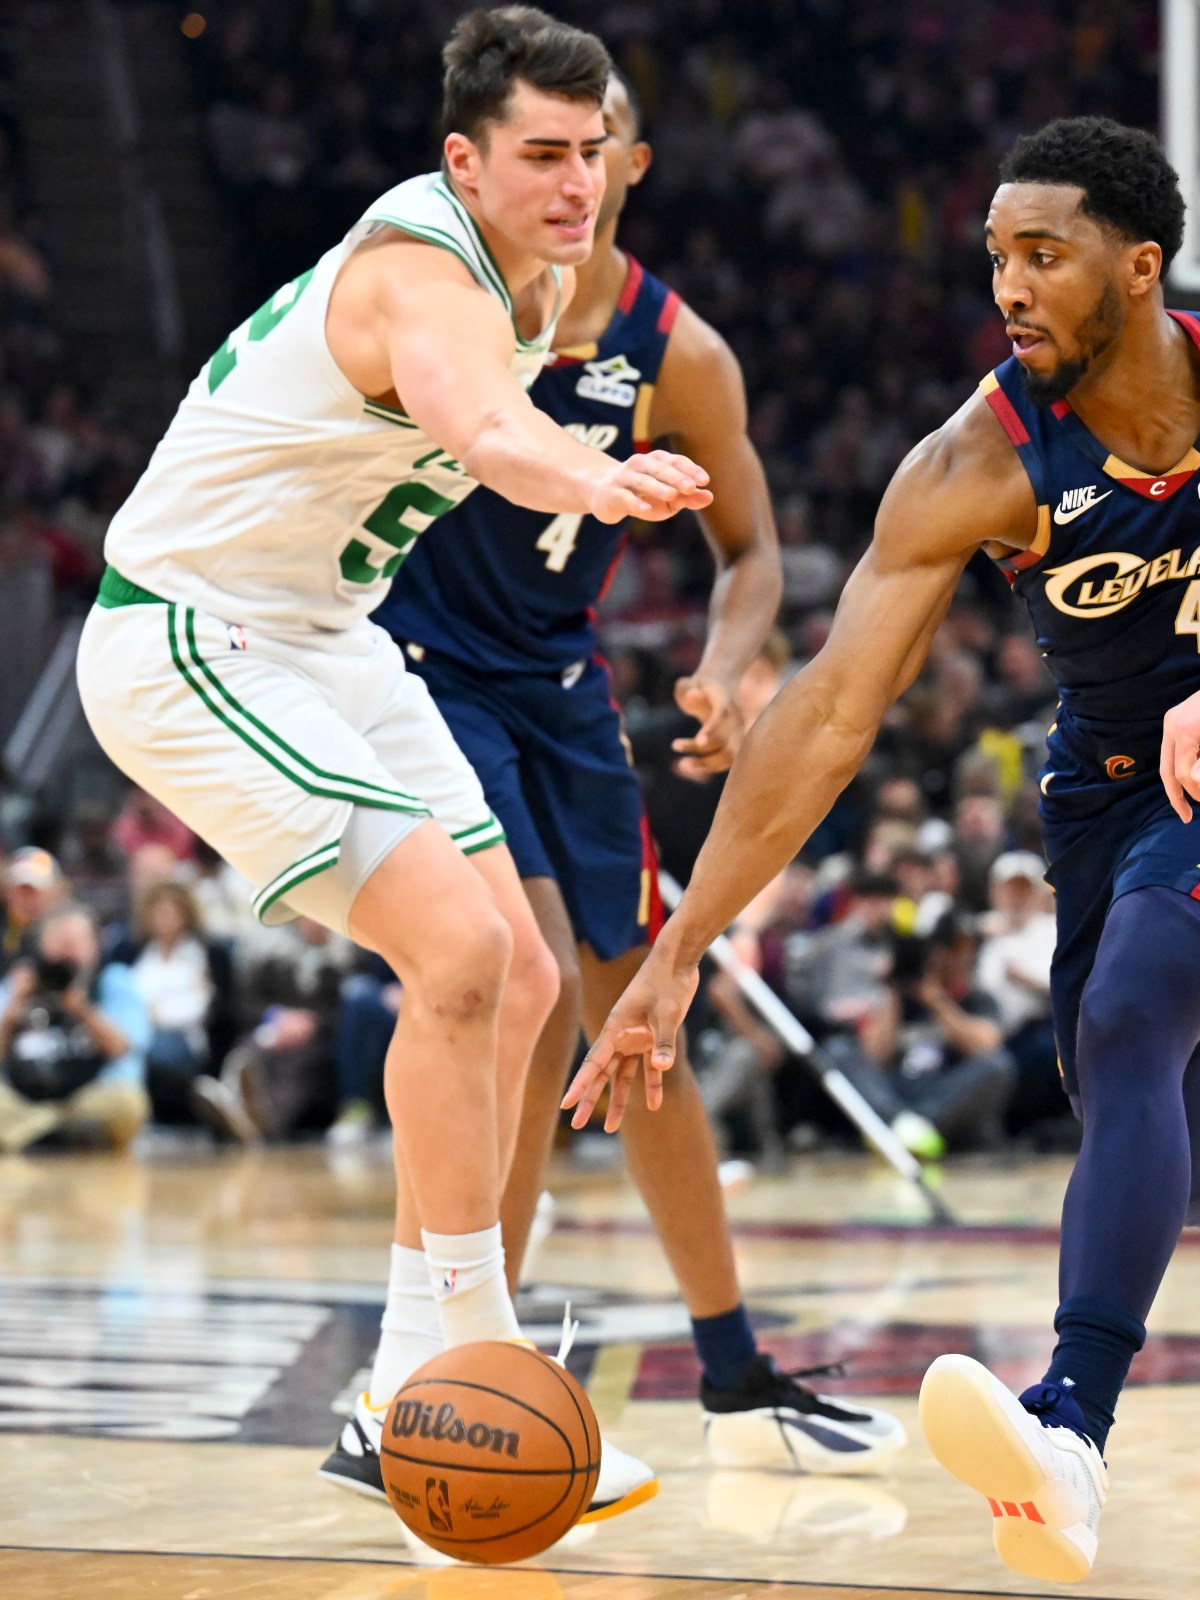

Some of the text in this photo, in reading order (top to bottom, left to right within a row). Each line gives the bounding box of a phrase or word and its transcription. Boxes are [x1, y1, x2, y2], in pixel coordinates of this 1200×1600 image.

[1061, 485, 1097, 511] NIKE
[1150, 481, 1167, 496] C
[536, 511, 584, 573] 4
[391, 1400, 520, 1459] Wilson
